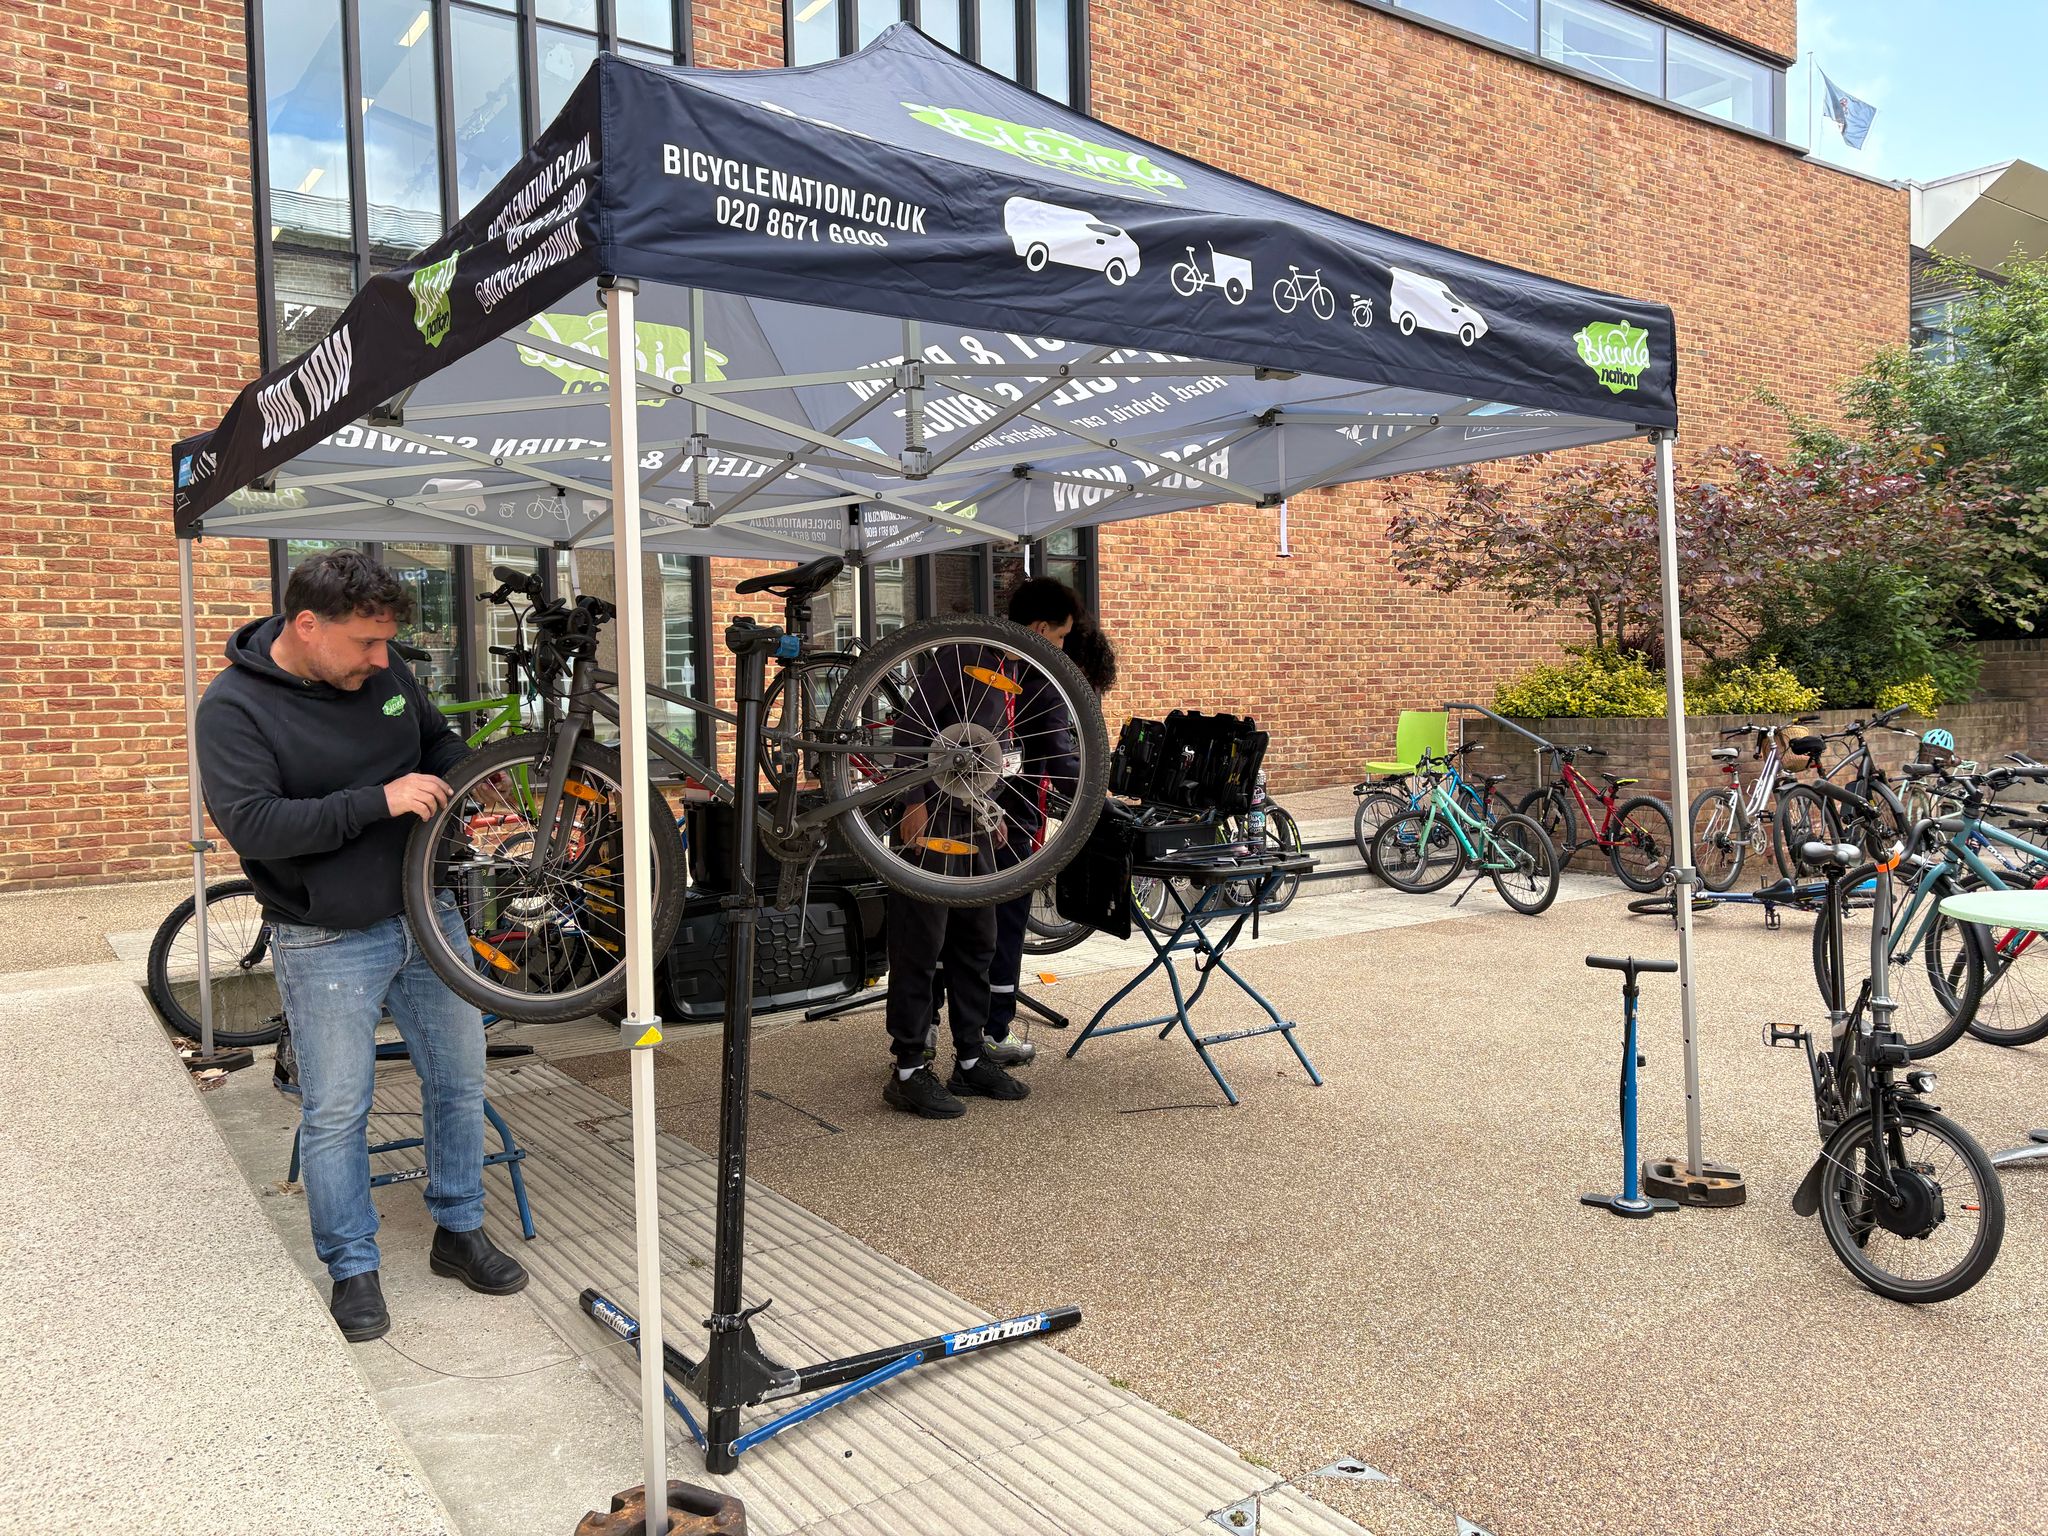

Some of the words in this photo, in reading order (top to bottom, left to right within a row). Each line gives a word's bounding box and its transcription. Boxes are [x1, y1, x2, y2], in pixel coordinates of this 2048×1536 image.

[487, 131, 591, 242] BICYCLENATION.CO.UK
[663, 143, 927, 235] BICYCLENATION.CO.UK
[716, 195, 760, 232] 020
[766, 208, 820, 242] 8671
[828, 223, 889, 247] 6900
[475, 217, 583, 315] @BICYCLENATIONUK
[426, 311, 450, 341] nation
[1573, 320, 1650, 370] Bicycle
[257, 369, 306, 450] BOOK
[298, 323, 353, 422] NOW
[1601, 367, 1637, 387] nation
